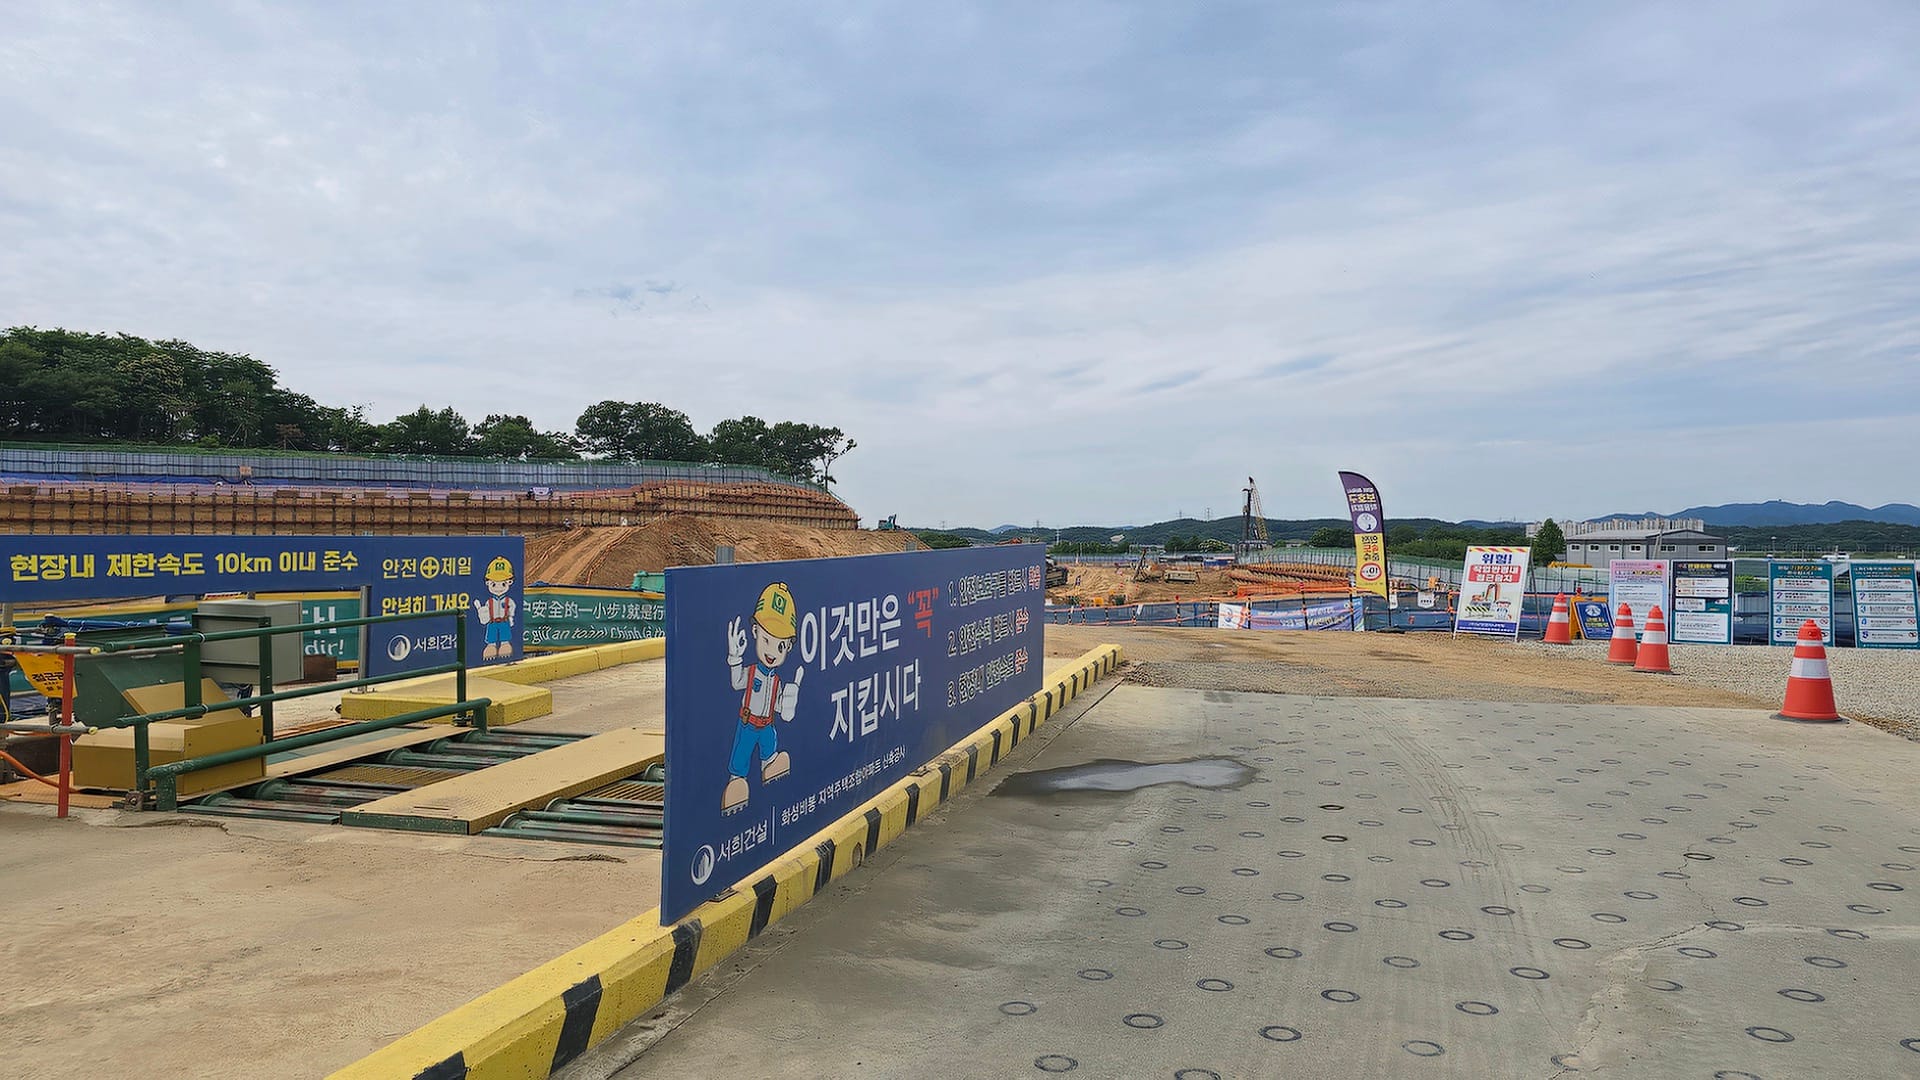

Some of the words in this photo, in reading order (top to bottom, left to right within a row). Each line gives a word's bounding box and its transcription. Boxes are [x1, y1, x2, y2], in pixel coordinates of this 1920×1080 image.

[10, 554, 95, 581] 현장내
[106, 552, 206, 577] 제한속도
[215, 552, 272, 573] 10km
[279, 550, 316, 571] 이내
[322, 550, 359, 571] 준수
[382, 558, 417, 579] 안전
[441, 557, 472, 576] 제일
[1482, 553, 1513, 565] 위험!
[958, 570, 1007, 607] 안전보호구를
[1008, 567, 1028, 595] 반드시
[1028, 564, 1041, 591] 착용
[382, 595, 426, 617] 안녕히
[431, 592, 470, 613] 가세요
[800, 594, 902, 671] 이것만은
[907, 587, 940, 638] “꼭”
[958, 616, 992, 655] 안전수칙
[993, 609, 1015, 643] 반드시
[1015, 606, 1029, 634] 준수
[1015, 646, 1029, 675] 준수
[829, 658, 922, 743] 지킵시다
[717, 820, 768, 862] 서희건설
[781, 796, 817, 826] 화성비봉
[818, 758, 882, 804] 지역주택조합아파트
[883, 745, 906, 769] 신축공사
